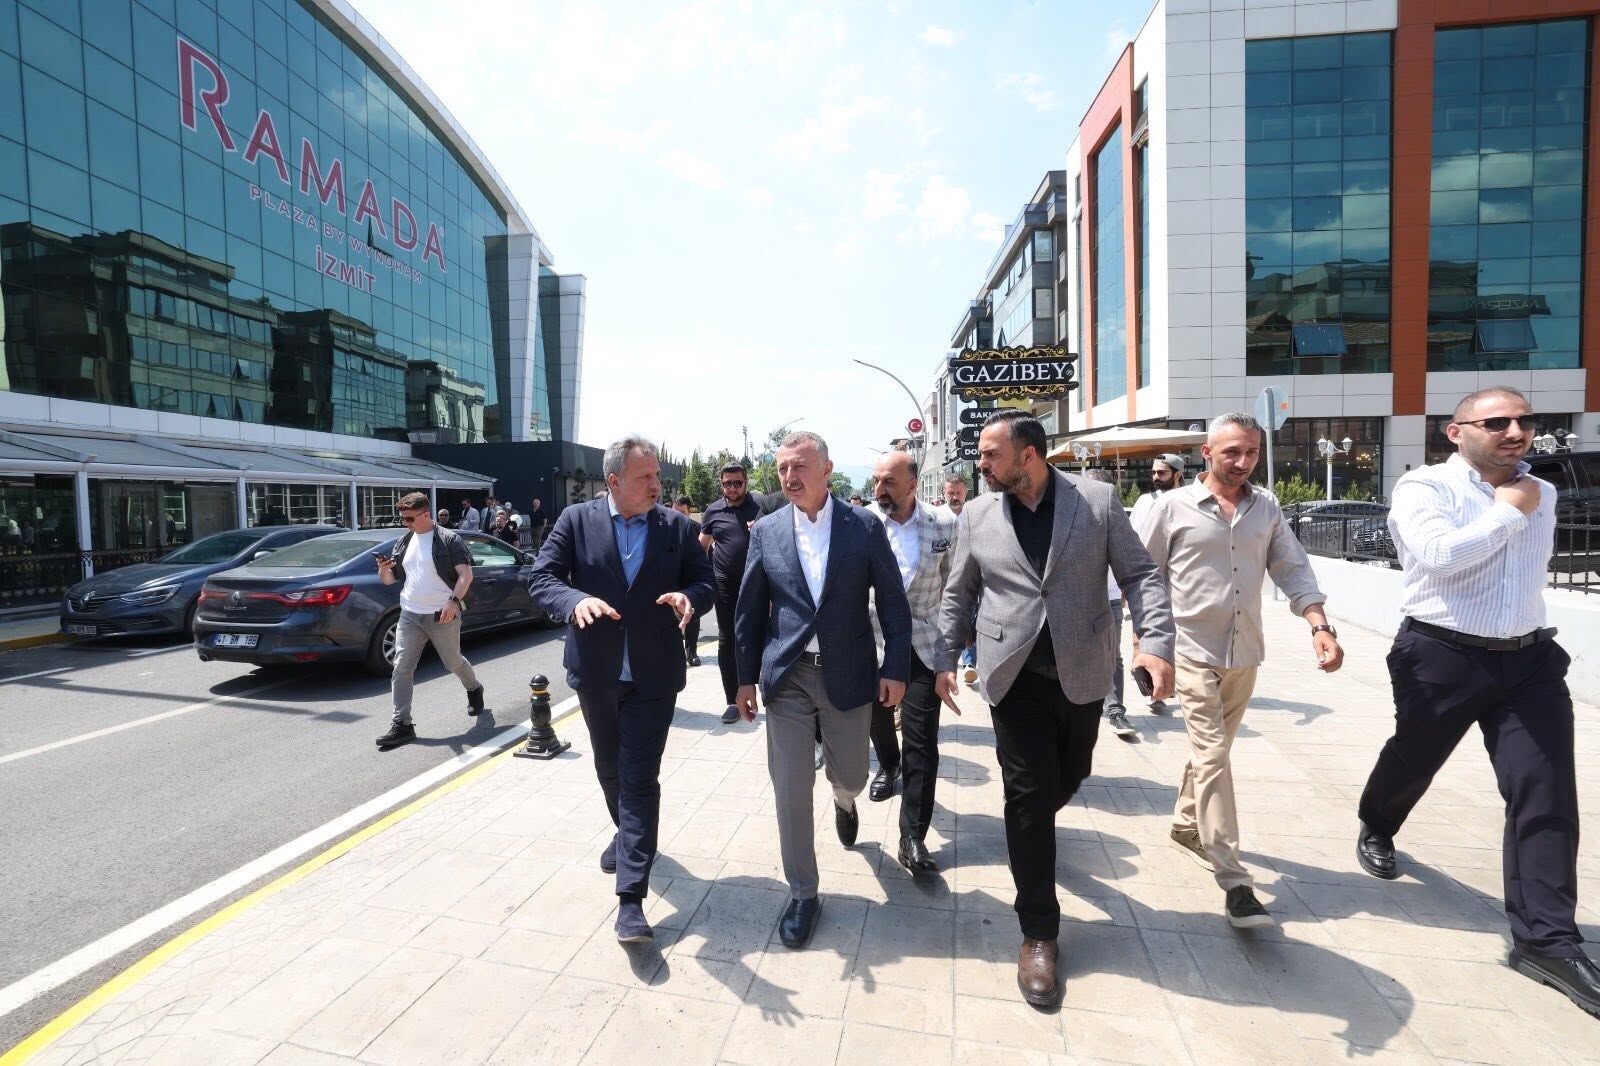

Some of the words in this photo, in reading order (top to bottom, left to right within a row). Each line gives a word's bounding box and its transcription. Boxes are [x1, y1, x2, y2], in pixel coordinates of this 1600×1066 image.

[177, 35, 447, 272] RAMADA
[249, 183, 319, 232] PLAZA
[323, 222, 345, 244] BY
[350, 235, 422, 285] WYNDHAM
[315, 245, 376, 294] İZMİT
[955, 360, 1071, 383] GAZİBEY
